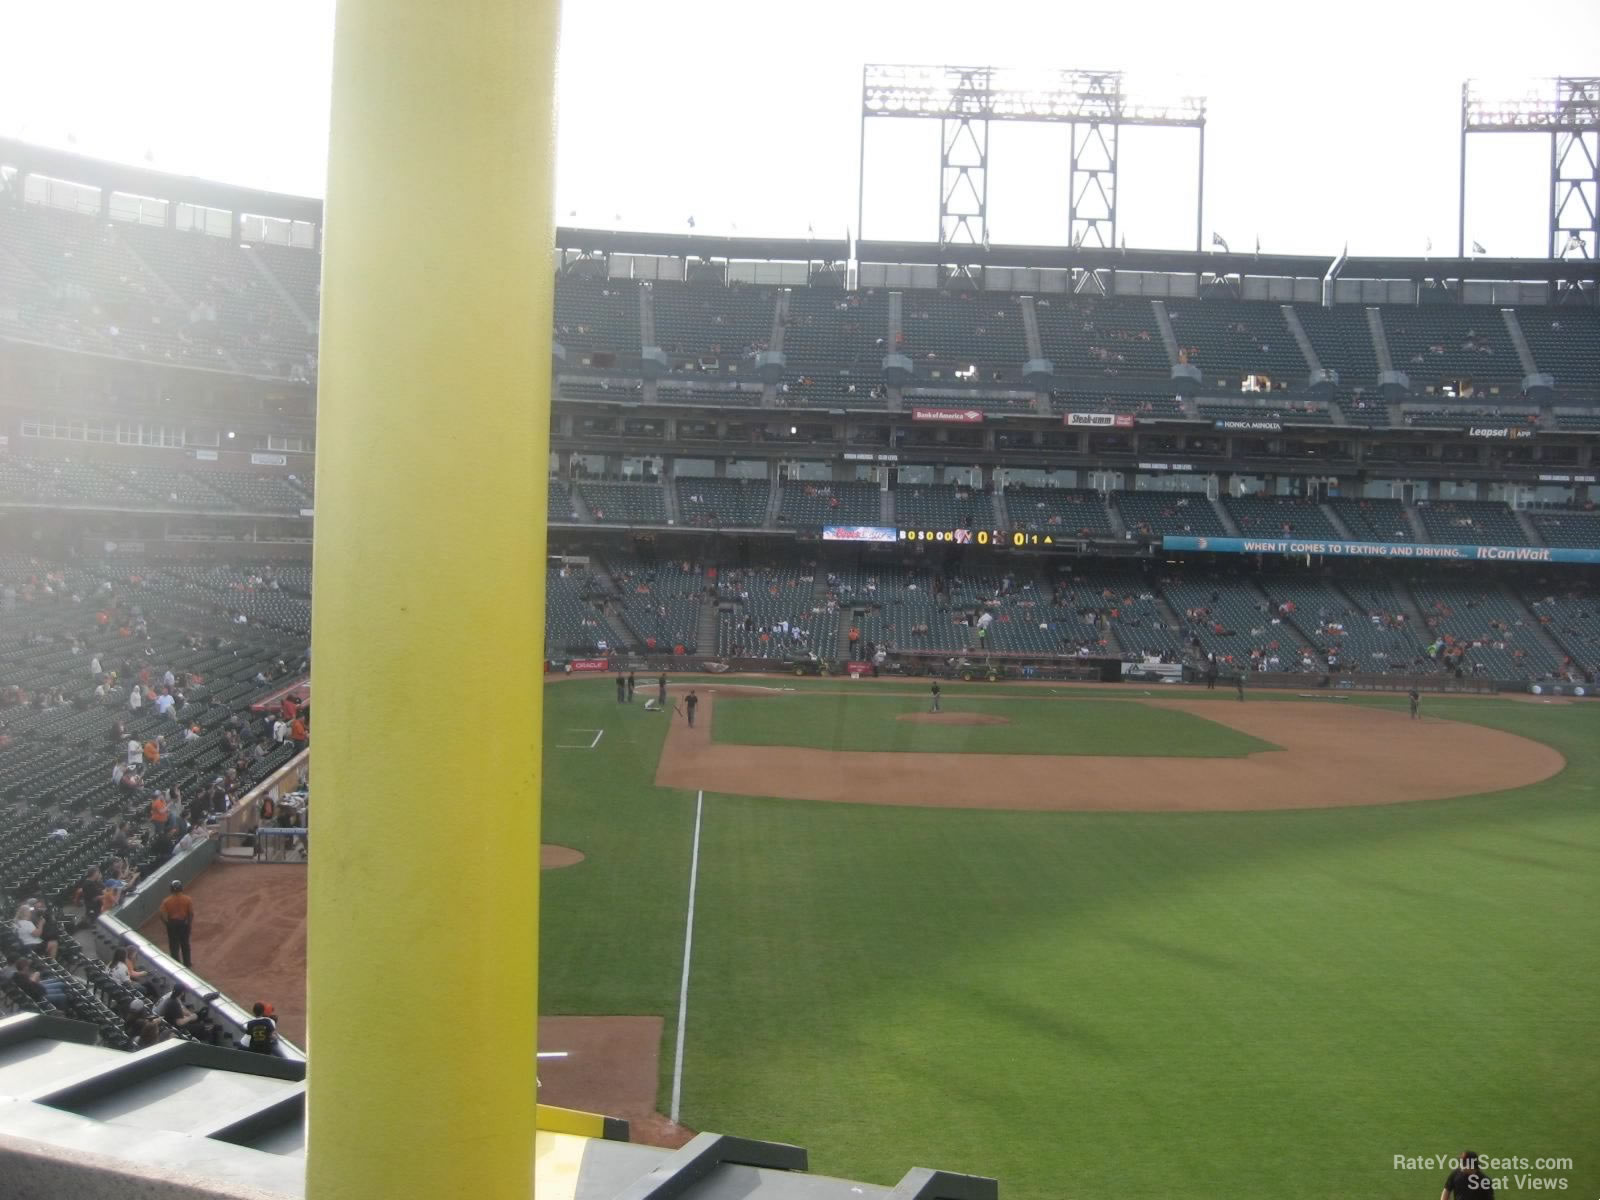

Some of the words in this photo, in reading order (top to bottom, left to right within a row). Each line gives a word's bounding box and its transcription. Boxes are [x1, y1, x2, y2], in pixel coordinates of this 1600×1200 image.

[939, 412, 964, 420] America
[1072, 414, 1111, 424] Steak-umm
[1224, 421, 1250, 429] KONICA
[1251, 422, 1280, 430] MINOLTA
[1031, 534, 1038, 544] 1
[1244, 541, 1275, 551] WHEN
[1278, 543, 1288, 551] IT
[1290, 543, 1325, 552] COMES
[1328, 544, 1341, 553] TO
[1344, 545, 1387, 555] TEXTING
[1390, 547, 1412, 556] AND
